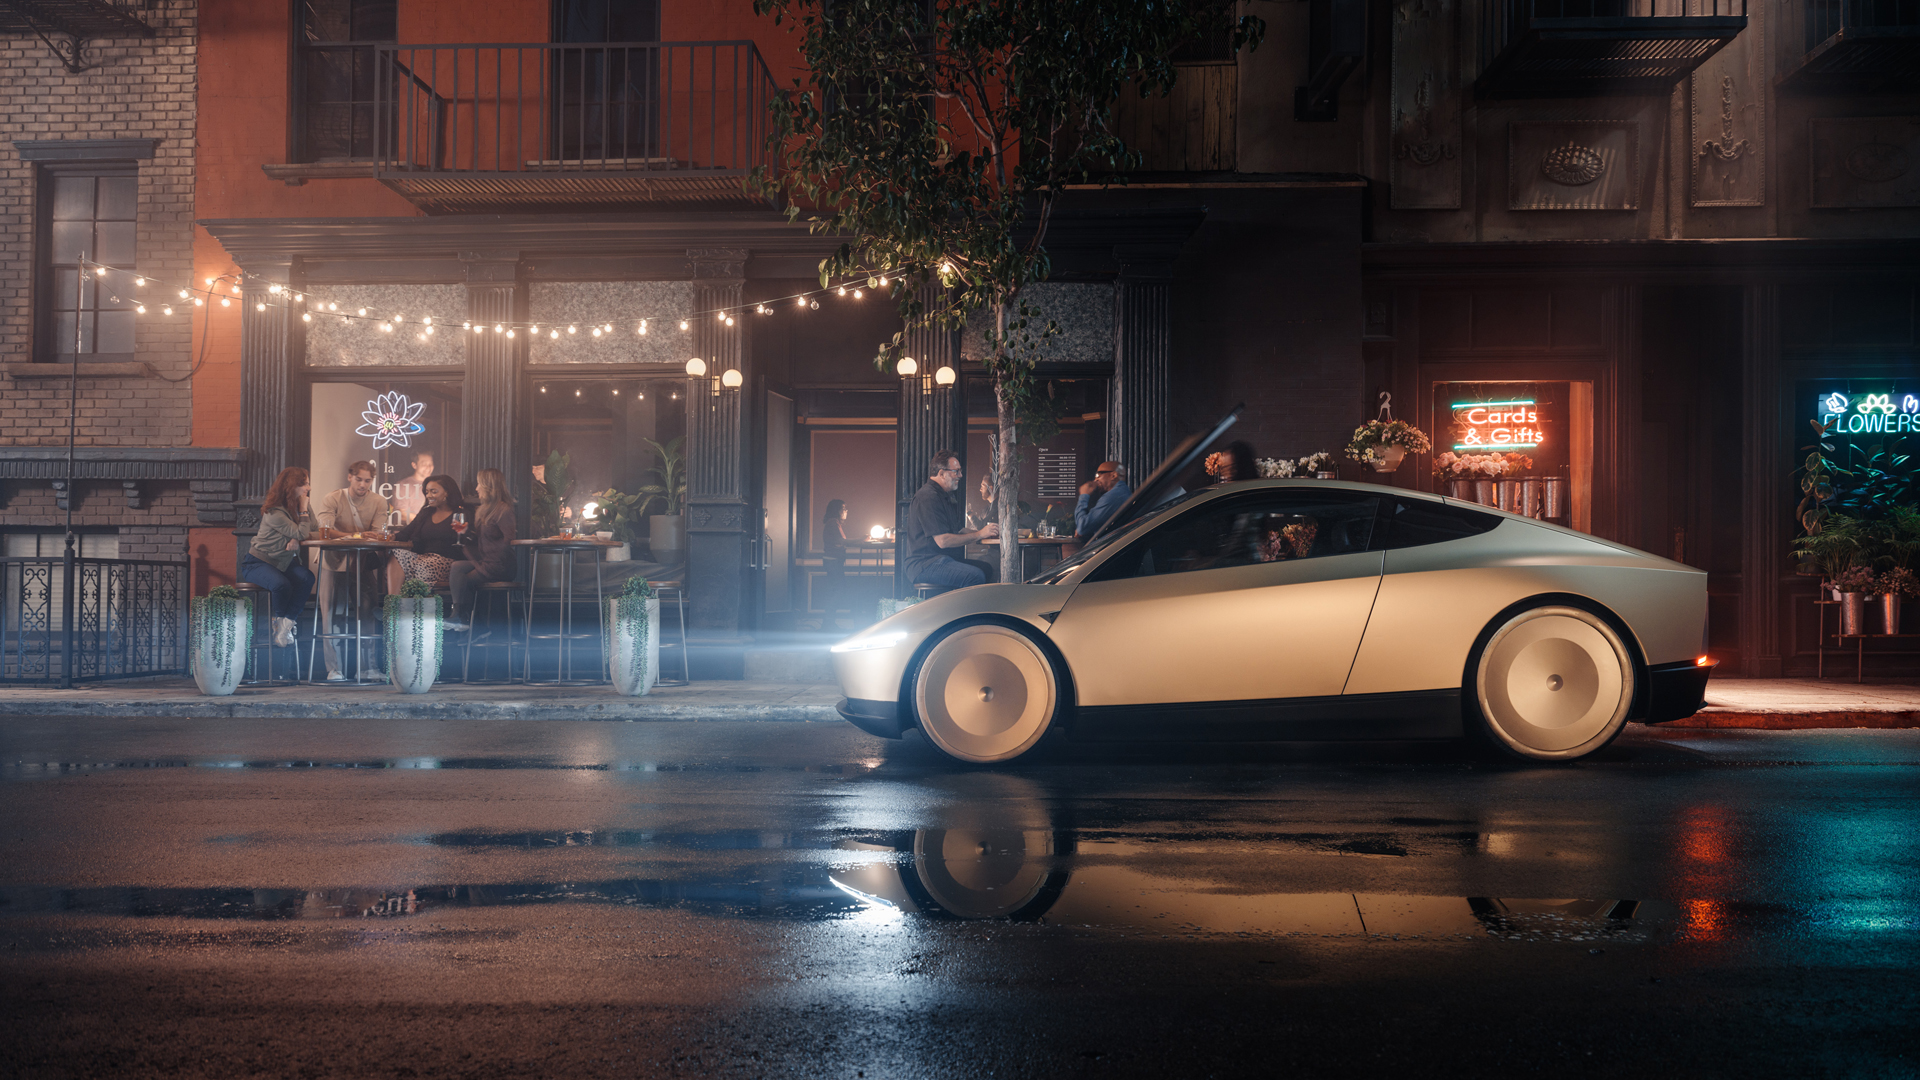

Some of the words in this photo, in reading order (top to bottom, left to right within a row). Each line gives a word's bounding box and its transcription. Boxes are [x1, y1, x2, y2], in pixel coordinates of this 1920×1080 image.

[1467, 407, 1537, 425] Cards
[1823, 413, 1920, 433] FLOWERS
[1464, 427, 1482, 445] &
[1490, 426, 1544, 444] Gifts
[384, 462, 395, 474] la
[369, 459, 424, 500] leur
